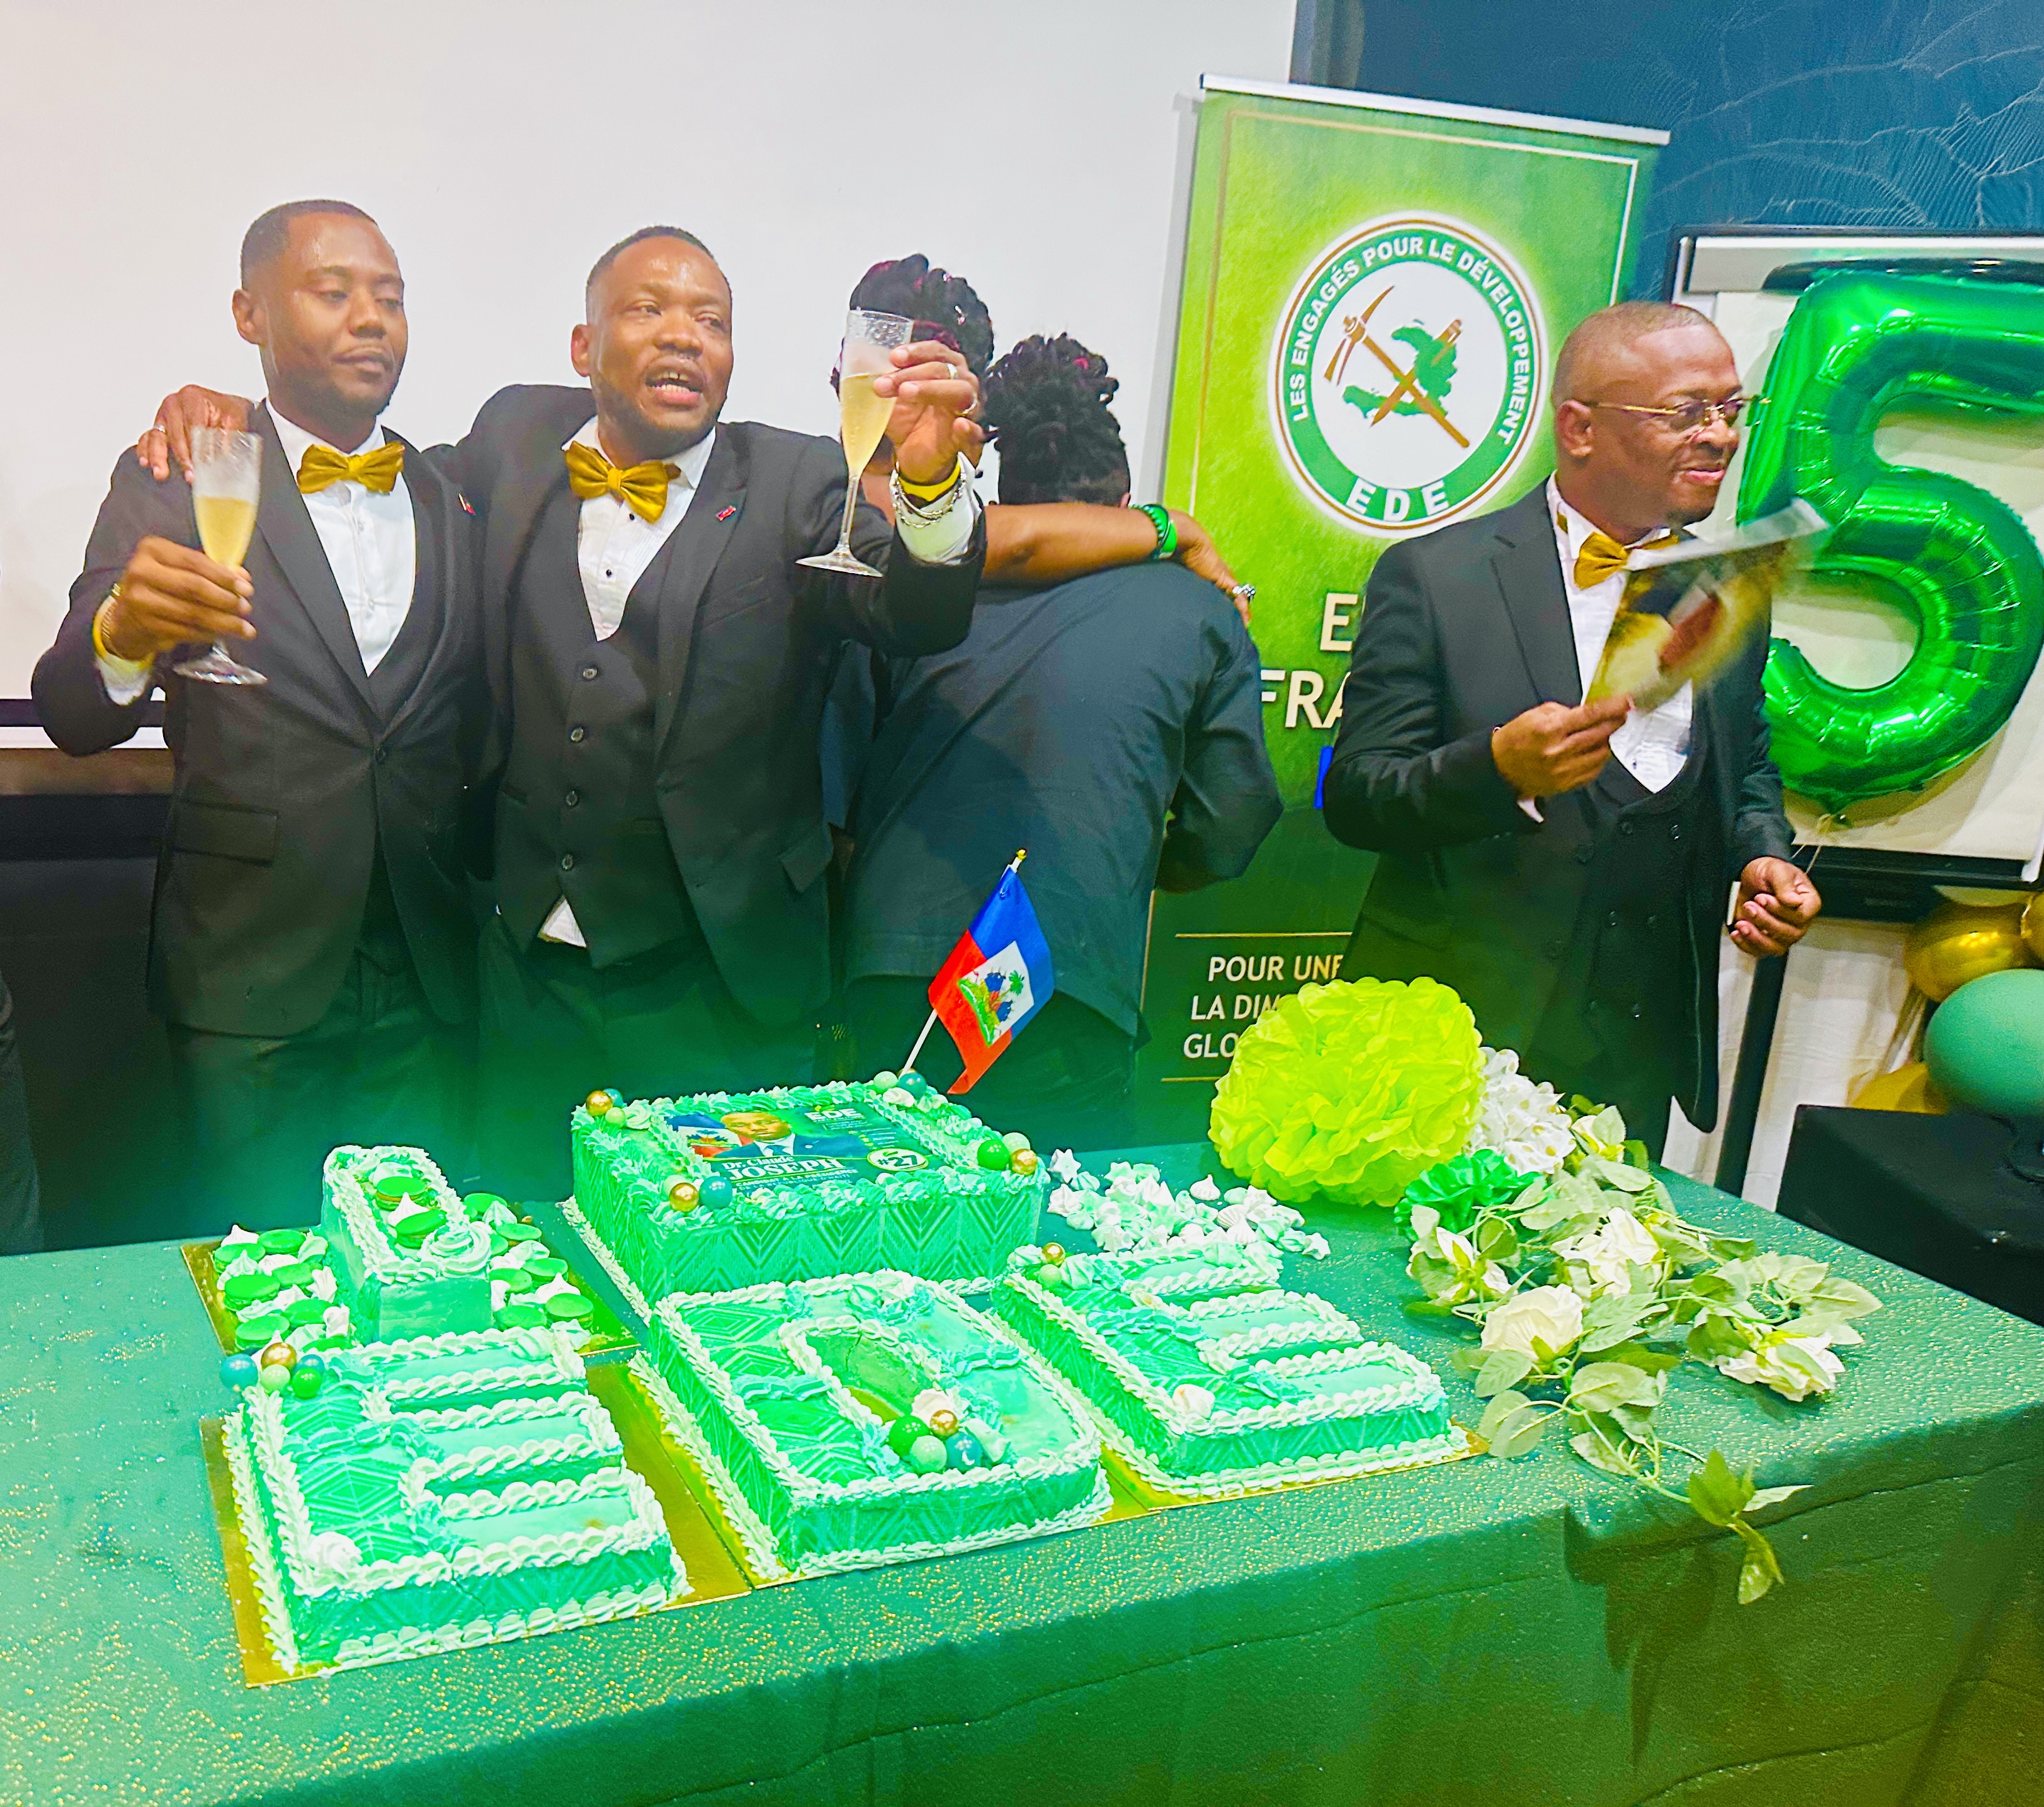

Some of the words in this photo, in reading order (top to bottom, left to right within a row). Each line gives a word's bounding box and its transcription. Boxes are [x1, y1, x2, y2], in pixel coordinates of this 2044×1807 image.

[1361, 236, 1423, 269] POUR
[1428, 237, 1456, 263] LE
[1292, 259, 1360, 367] ENGAGÉS
[1456, 251, 1531, 446] DÉVELOPPEMENT
[1289, 374, 1309, 421] LES
[1346, 477, 1449, 522] EDE
[1260, 669, 1351, 728] FRA
[1208, 955, 1285, 982] POUR
[1191, 995, 1225, 1020] LA
[1233, 994, 1281, 1019] DIM
[1184, 1033, 1239, 1058] GLO
[804, 1108, 862, 1120] EDE
[722, 1161, 746, 1170] Dr.
[747, 1156, 795, 1166] Claude
[728, 1158, 846, 1180] JOSEPH
[877, 1154, 918, 1166] #27
